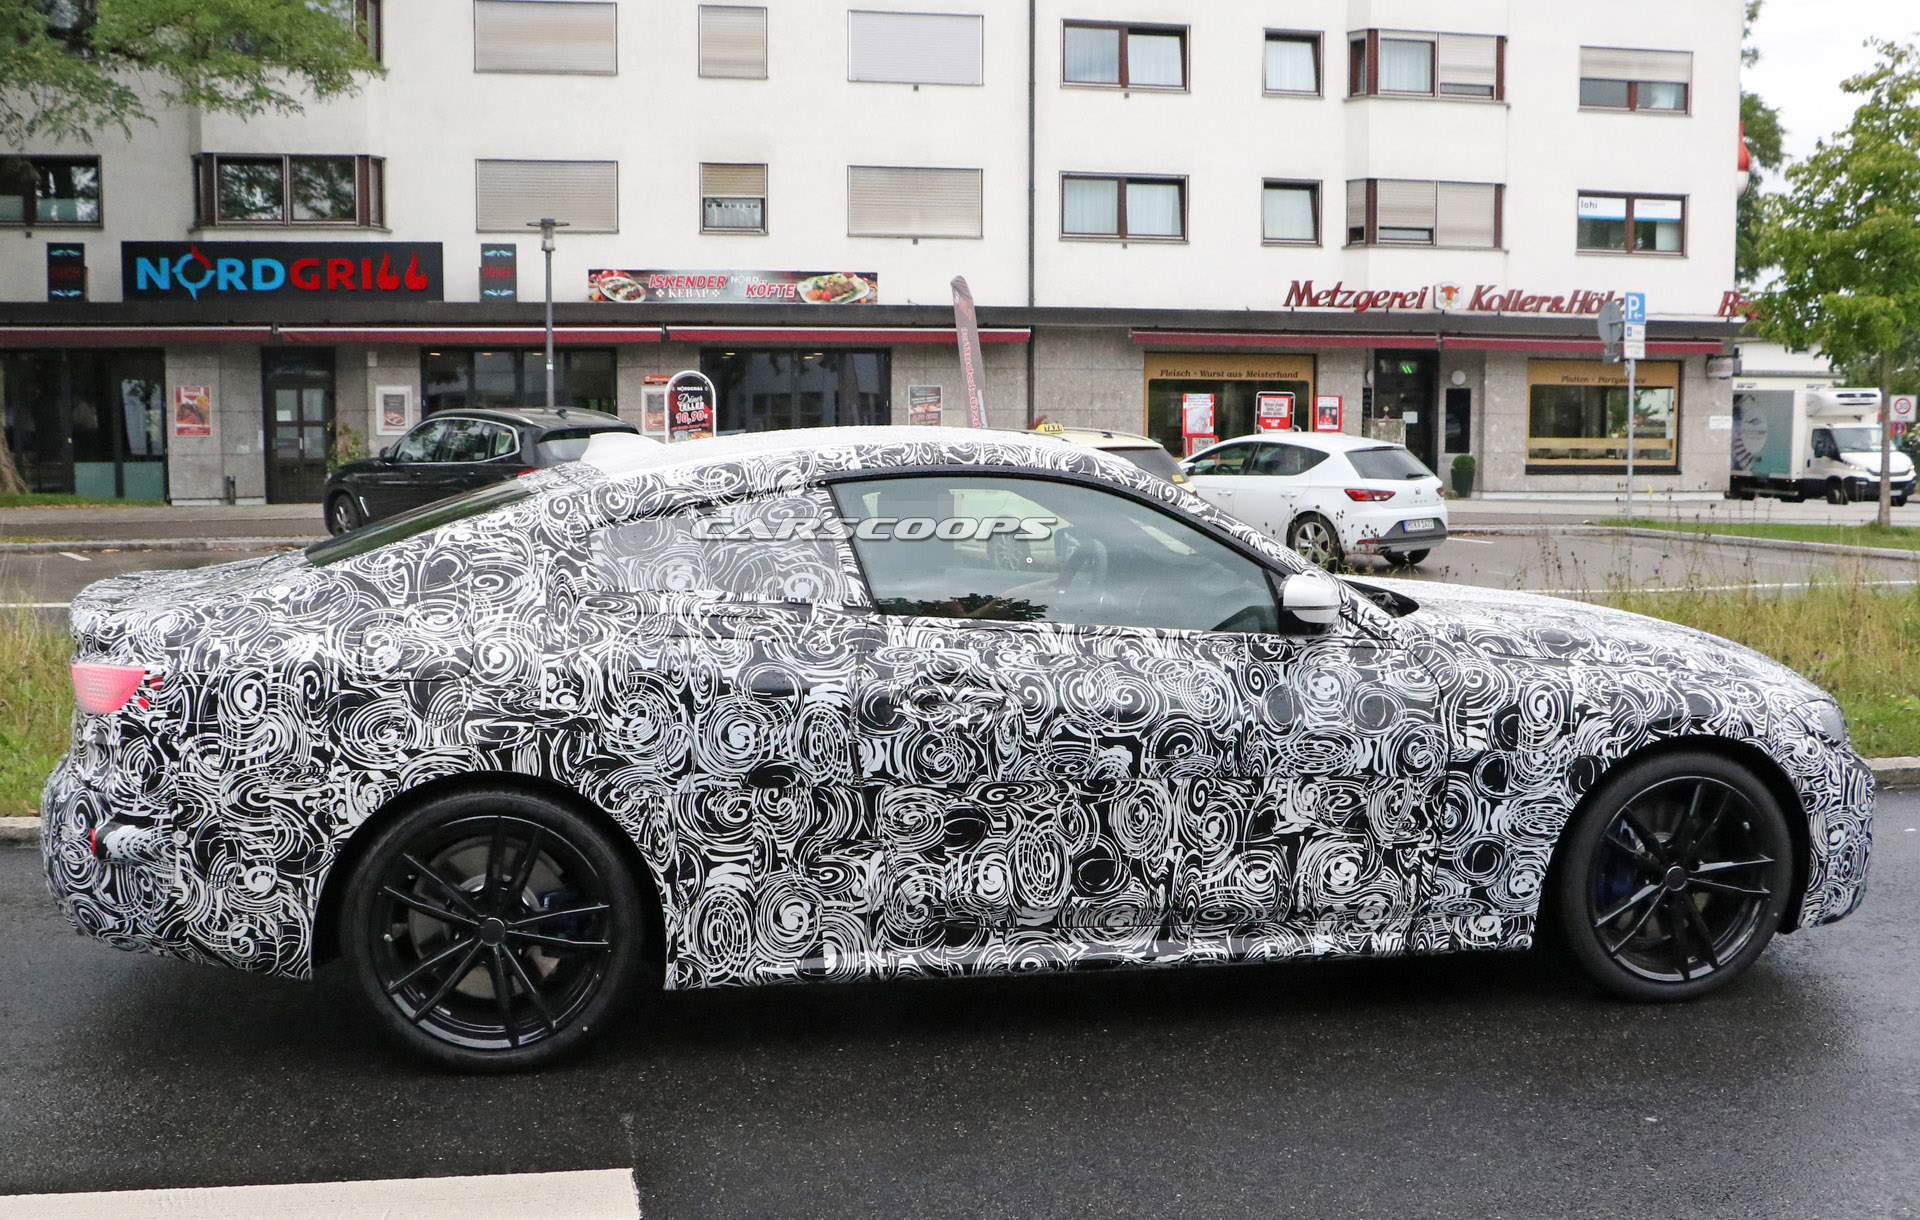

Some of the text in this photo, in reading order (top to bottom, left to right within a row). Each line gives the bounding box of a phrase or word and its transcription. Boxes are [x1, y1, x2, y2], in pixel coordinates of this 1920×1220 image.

[136, 244, 429, 300] NORDGRILL
[648, 274, 728, 289] ISKENDER
[745, 279, 796, 298] KÖFTE
[668, 288, 709, 298] KEBAP
[1283, 279, 1429, 312] Metzgerei
[1628, 295, 1640, 319] P
[1160, 369, 1191, 377] Fleisch
[1200, 369, 1226, 378] Wurst
[1246, 370, 1299, 379] Meisterhand
[677, 401, 705, 412] TELLER
[1044, 424, 1062, 432] TAXI
